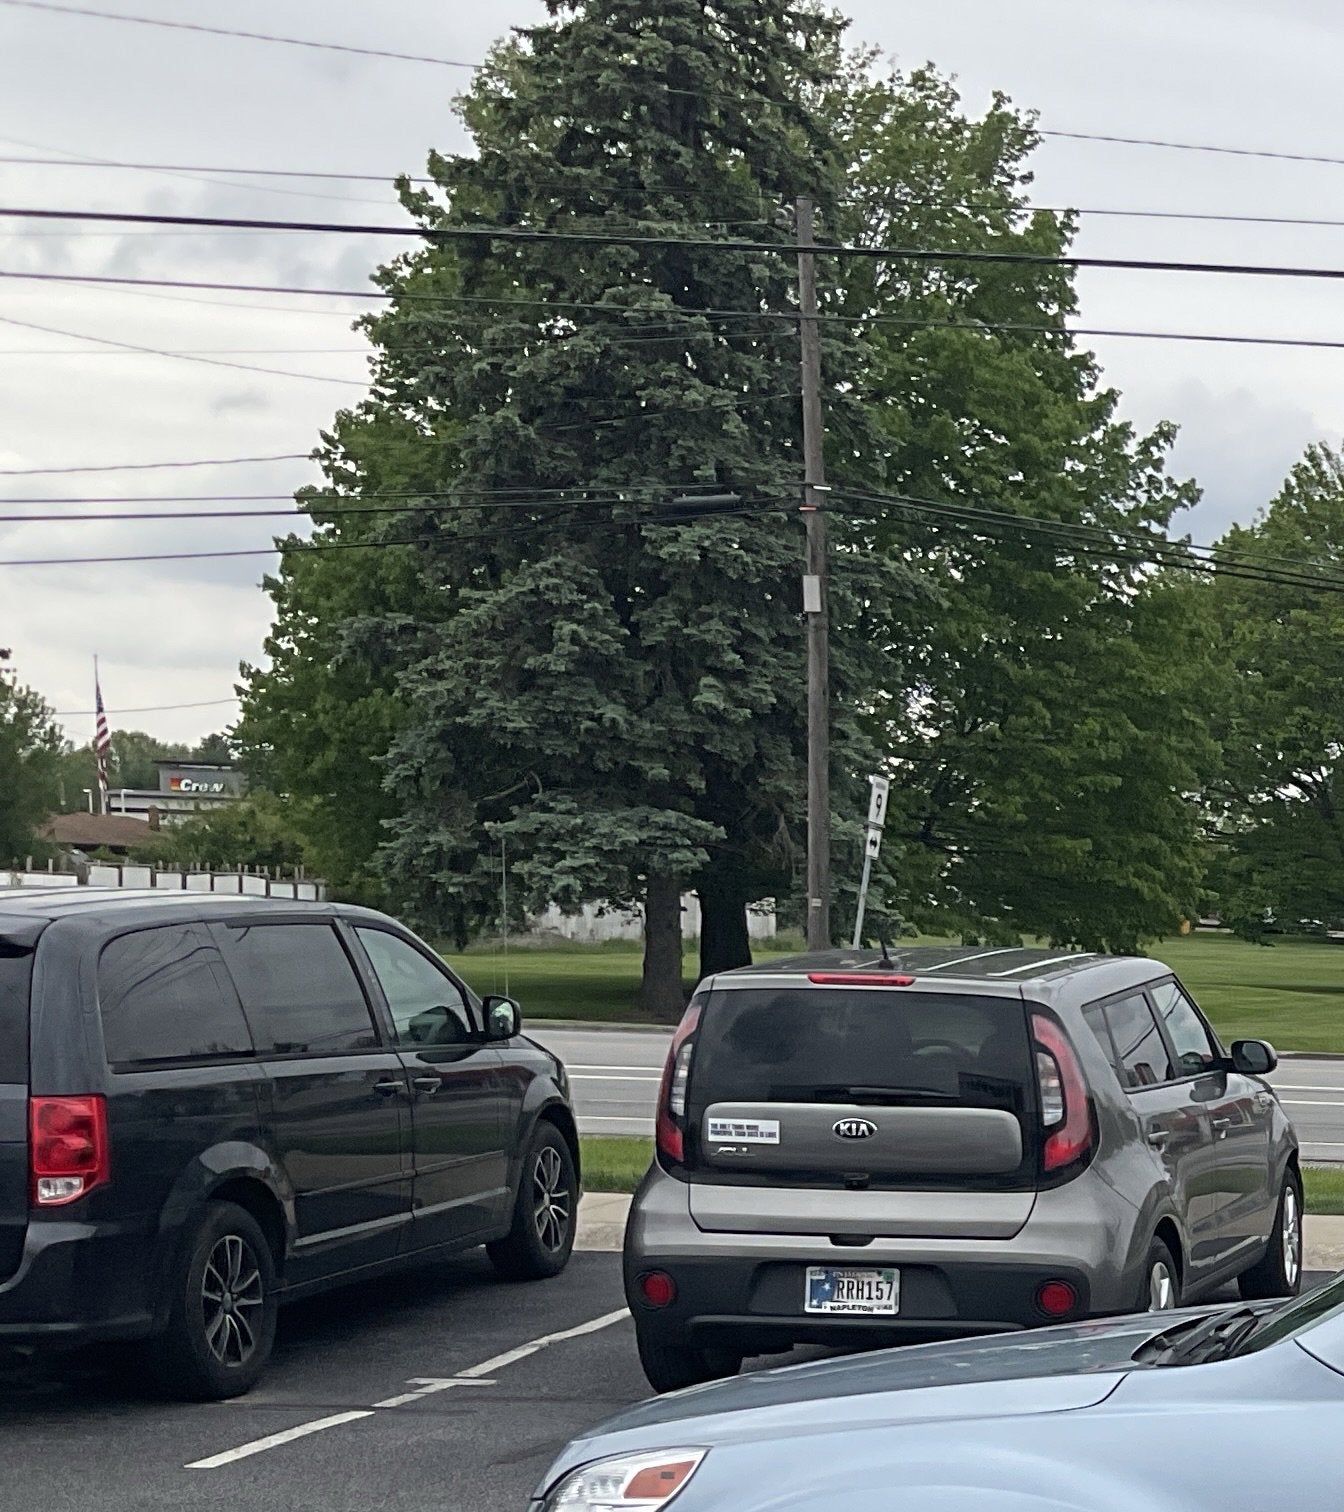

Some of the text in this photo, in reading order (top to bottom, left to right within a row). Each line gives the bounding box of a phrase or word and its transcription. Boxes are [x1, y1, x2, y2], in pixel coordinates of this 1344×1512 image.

[875, 794, 883, 818] 9
[840, 1123, 869, 1135] KIA
[837, 1280, 893, 1301] RRH157
